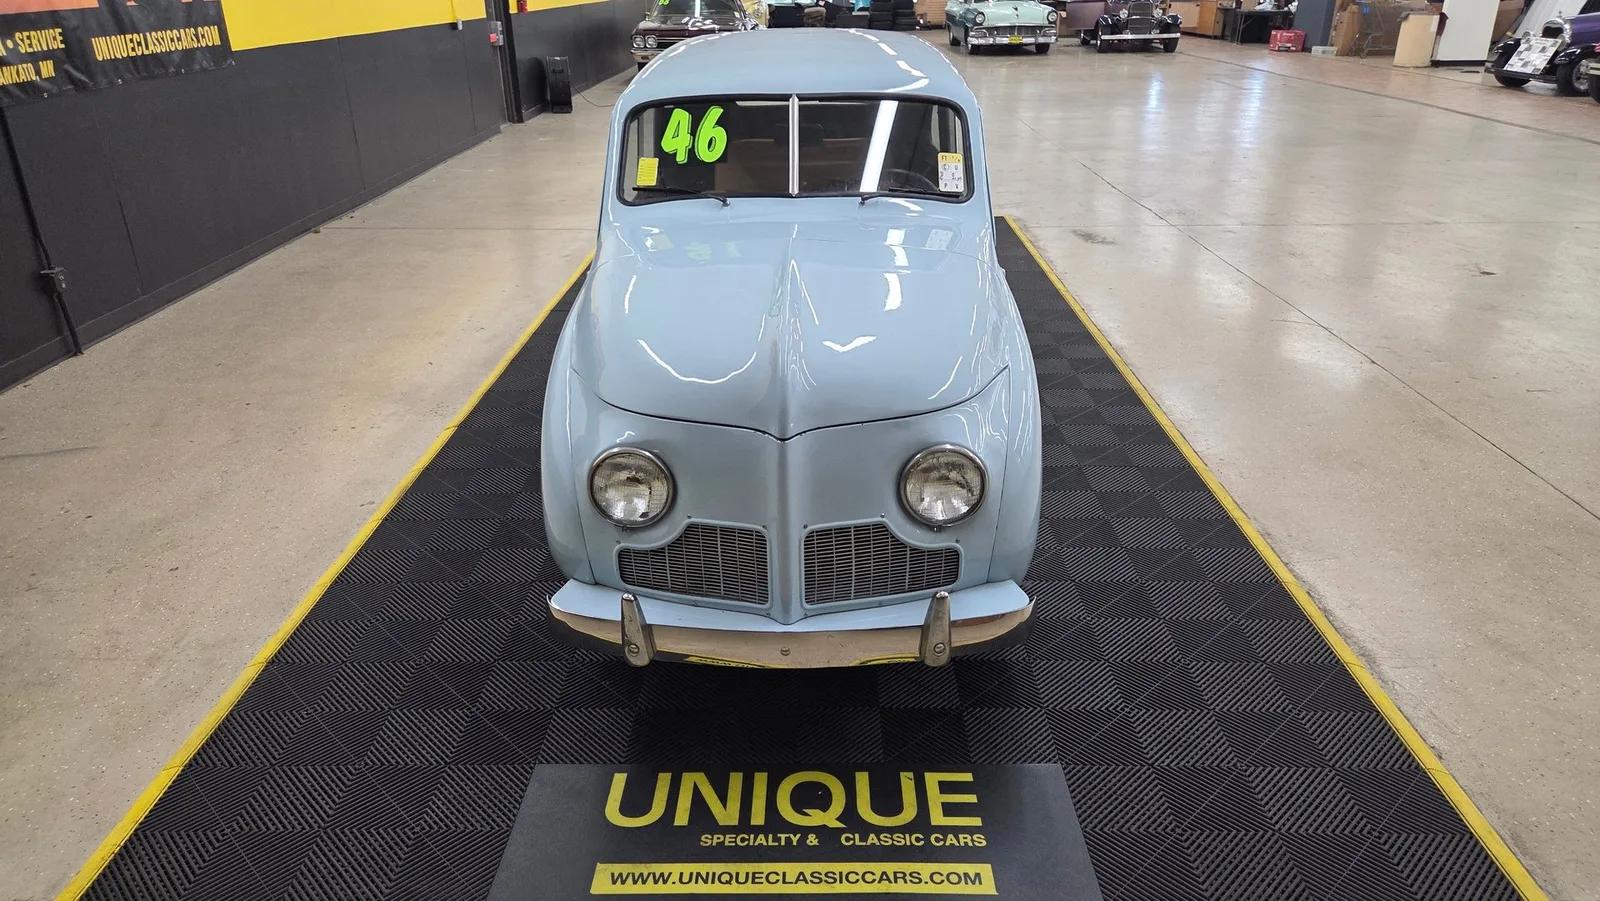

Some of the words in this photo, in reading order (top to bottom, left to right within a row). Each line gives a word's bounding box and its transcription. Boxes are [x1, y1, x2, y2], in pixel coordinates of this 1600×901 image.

[15, 28, 65, 53] SERVICE
[91, 25, 221, 61] UNIQUECLASSICCARS.COM
[39, 59, 56, 79] MN
[661, 105, 728, 164] 46
[604, 771, 983, 828] UNIQUE
[700, 833, 801, 847] SPECIALTY
[806, 833, 819, 846] &
[841, 833, 925, 847] CLASSIC
[930, 833, 987, 847] CARS
[610, 870, 983, 886] WWW.UNIQUECLASSICCARS.COM
